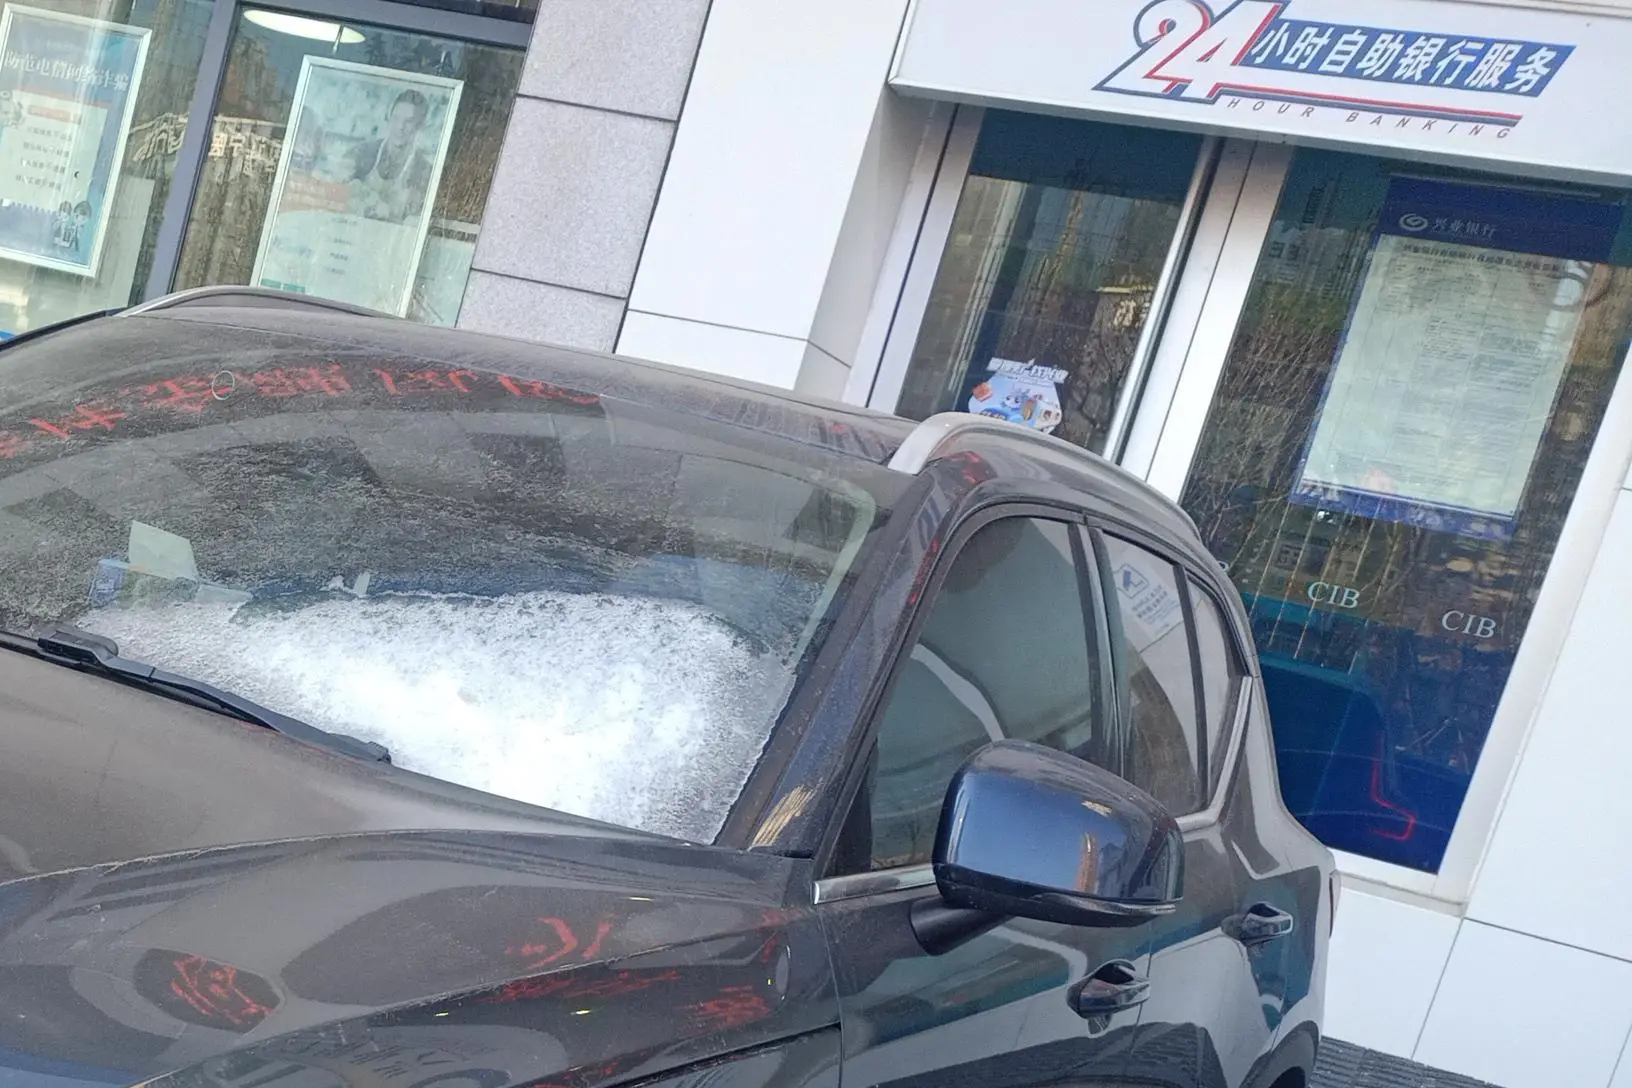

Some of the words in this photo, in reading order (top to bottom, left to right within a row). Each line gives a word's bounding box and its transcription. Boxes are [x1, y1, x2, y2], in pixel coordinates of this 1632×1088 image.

[1227, 97, 1315, 118] HOUR
[1345, 111, 1511, 139] BANKING
[1431, 217, 1497, 240] 兴业银行
[1308, 581, 1361, 609] CIB
[1441, 610, 1497, 638] CIB
